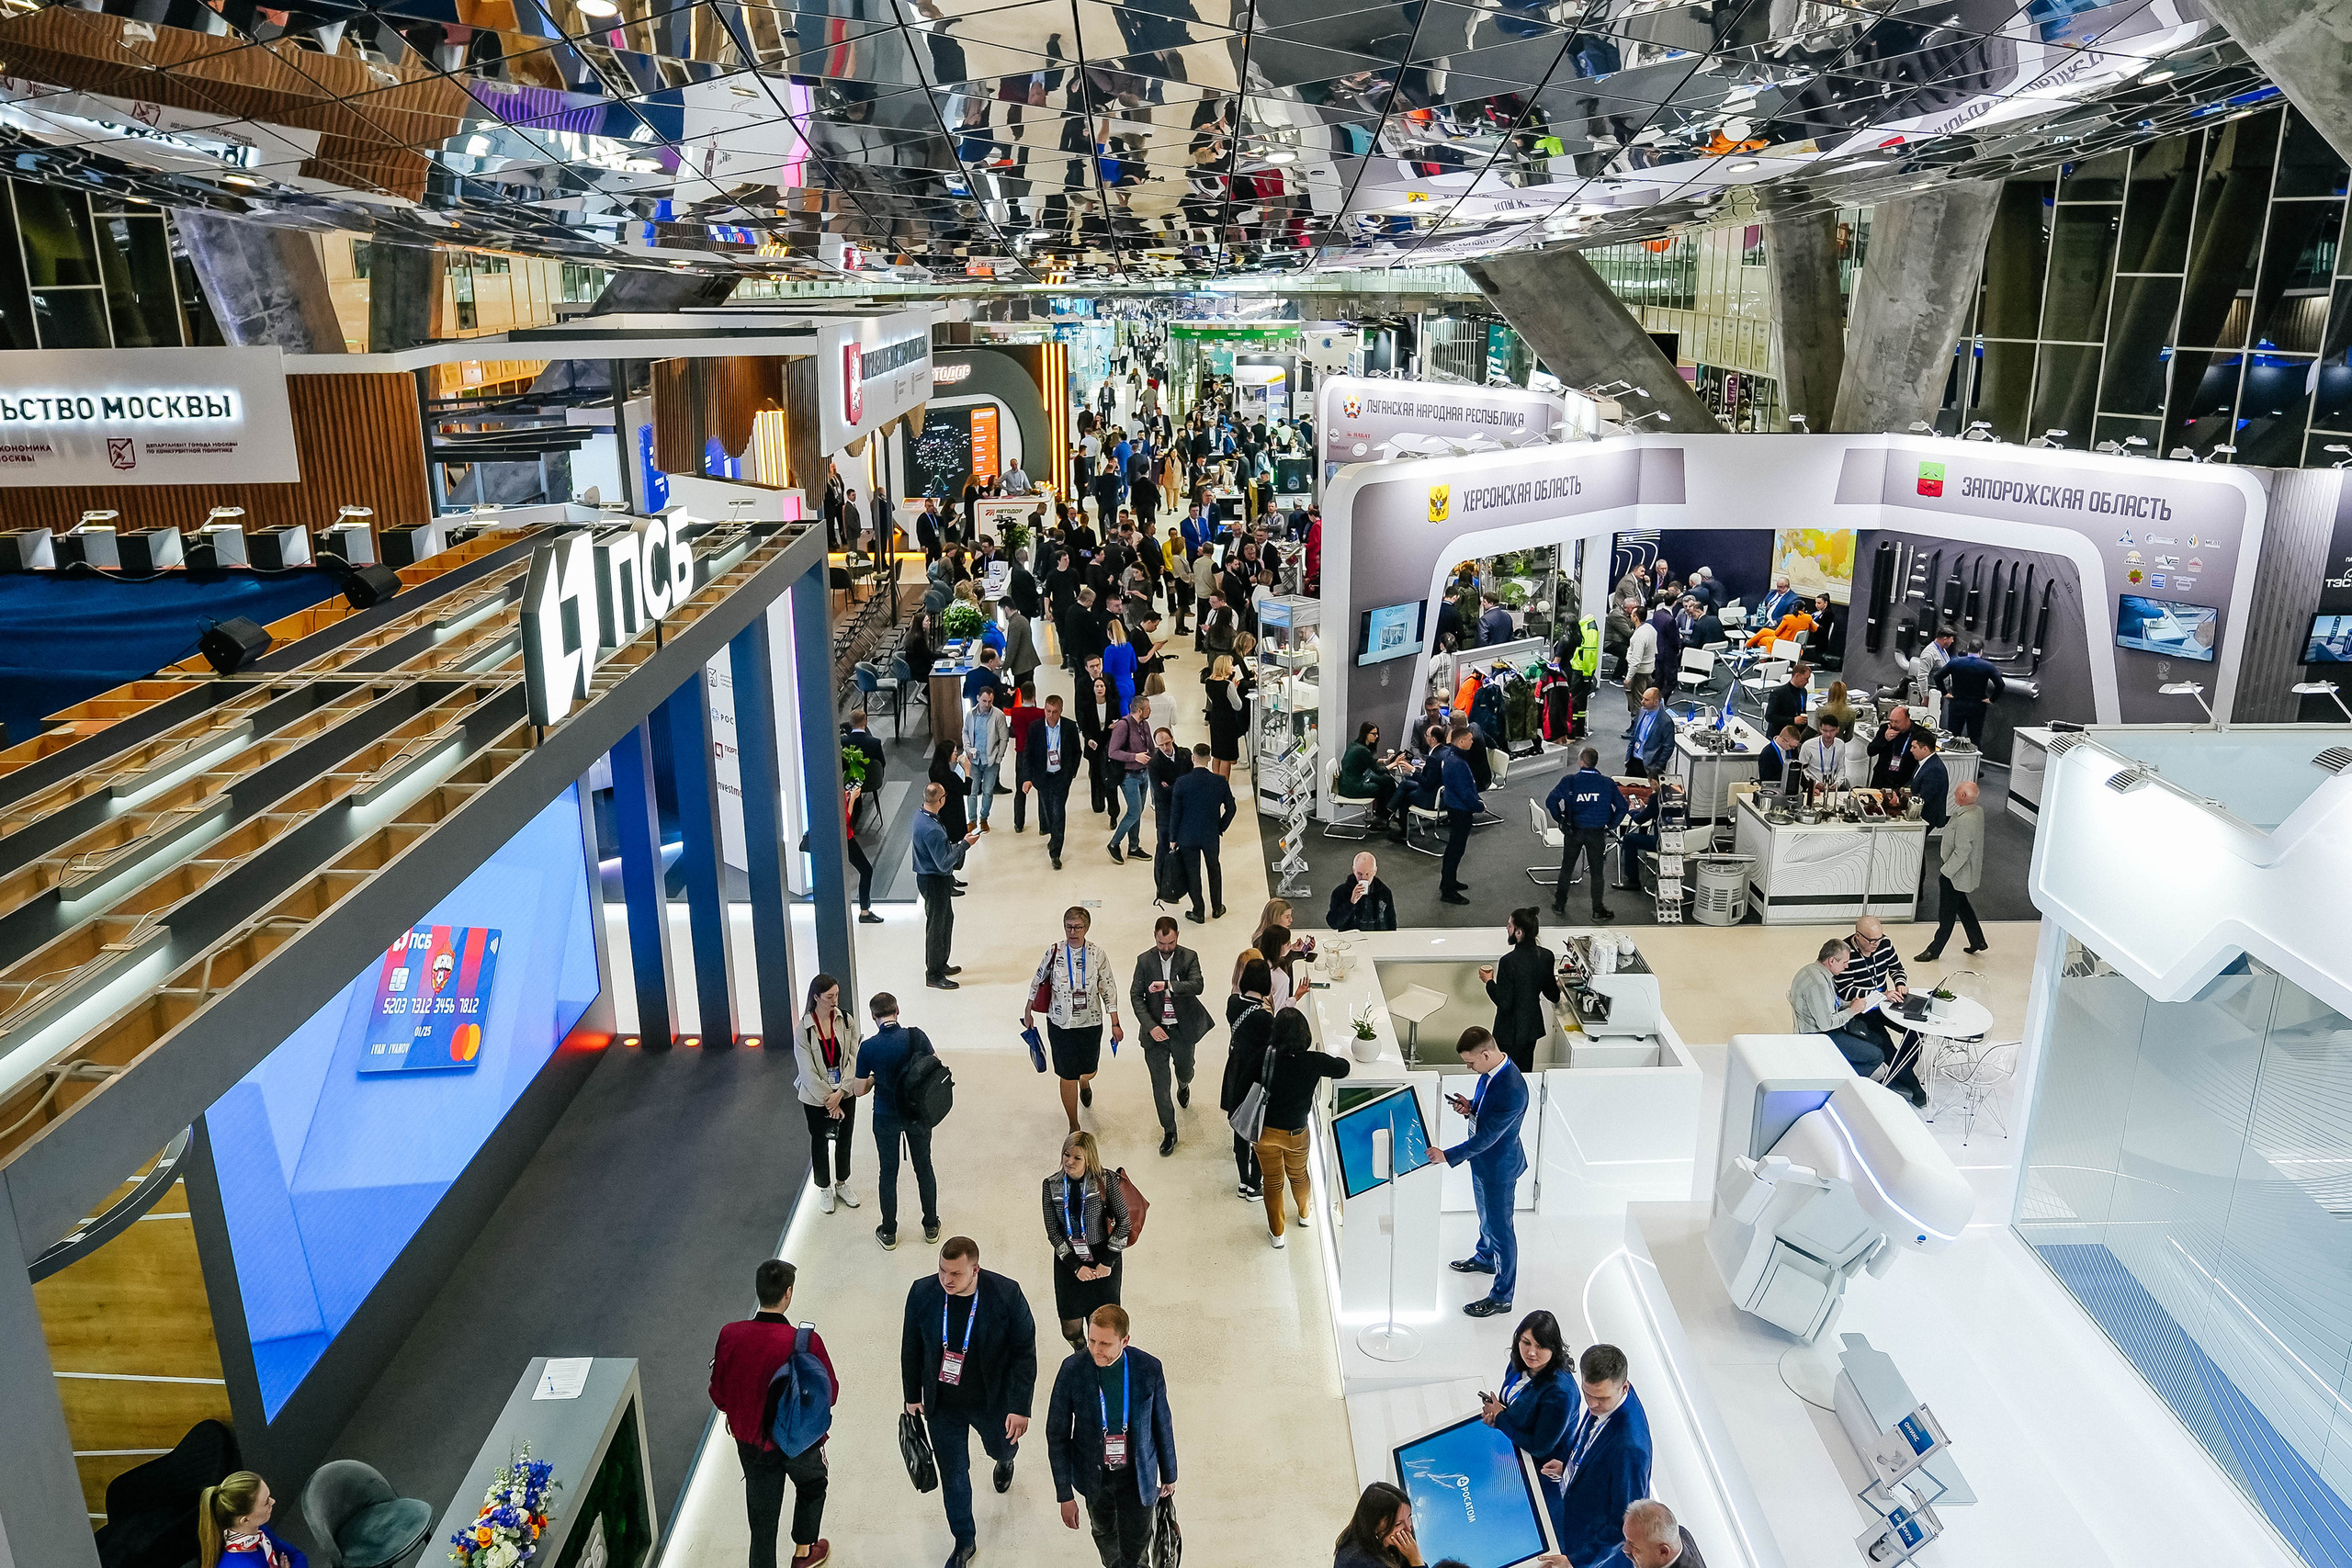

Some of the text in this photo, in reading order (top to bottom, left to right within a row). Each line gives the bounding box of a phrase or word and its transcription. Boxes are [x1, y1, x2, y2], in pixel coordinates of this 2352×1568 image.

[932, 365, 970, 382] ТОДОР
[0, 395, 232, 421] ЬСТВО МОСКВЫ
[1366, 399, 1524, 427] ЛУГАНСКАЯ НАРОДНАЯ РЕСПУБЛИКА
[1463, 475, 1581, 513] ХЕРСОНСКАЯ ОБЛАСТЬ
[1962, 476, 2172, 521] ЗАПОРОЖСКАЯ ОБЛАСТЬ
[606, 506, 694, 649] ПСБ
[2325, 579, 2352, 588] ТЭС
[720, 714, 734, 725] РОС
[1577, 793, 1600, 802] AVT
[409, 932, 433, 950] ПСБ
[382, 997, 480, 1014] 5203 7312 3456 7812
[413, 1025, 432, 1037] 01/25
[1904, 1421, 1920, 1443] ОНИКС
[1461, 1486, 1476, 1523] РОСАТОМ
[1894, 1513, 1914, 1542] БРХИУМ
